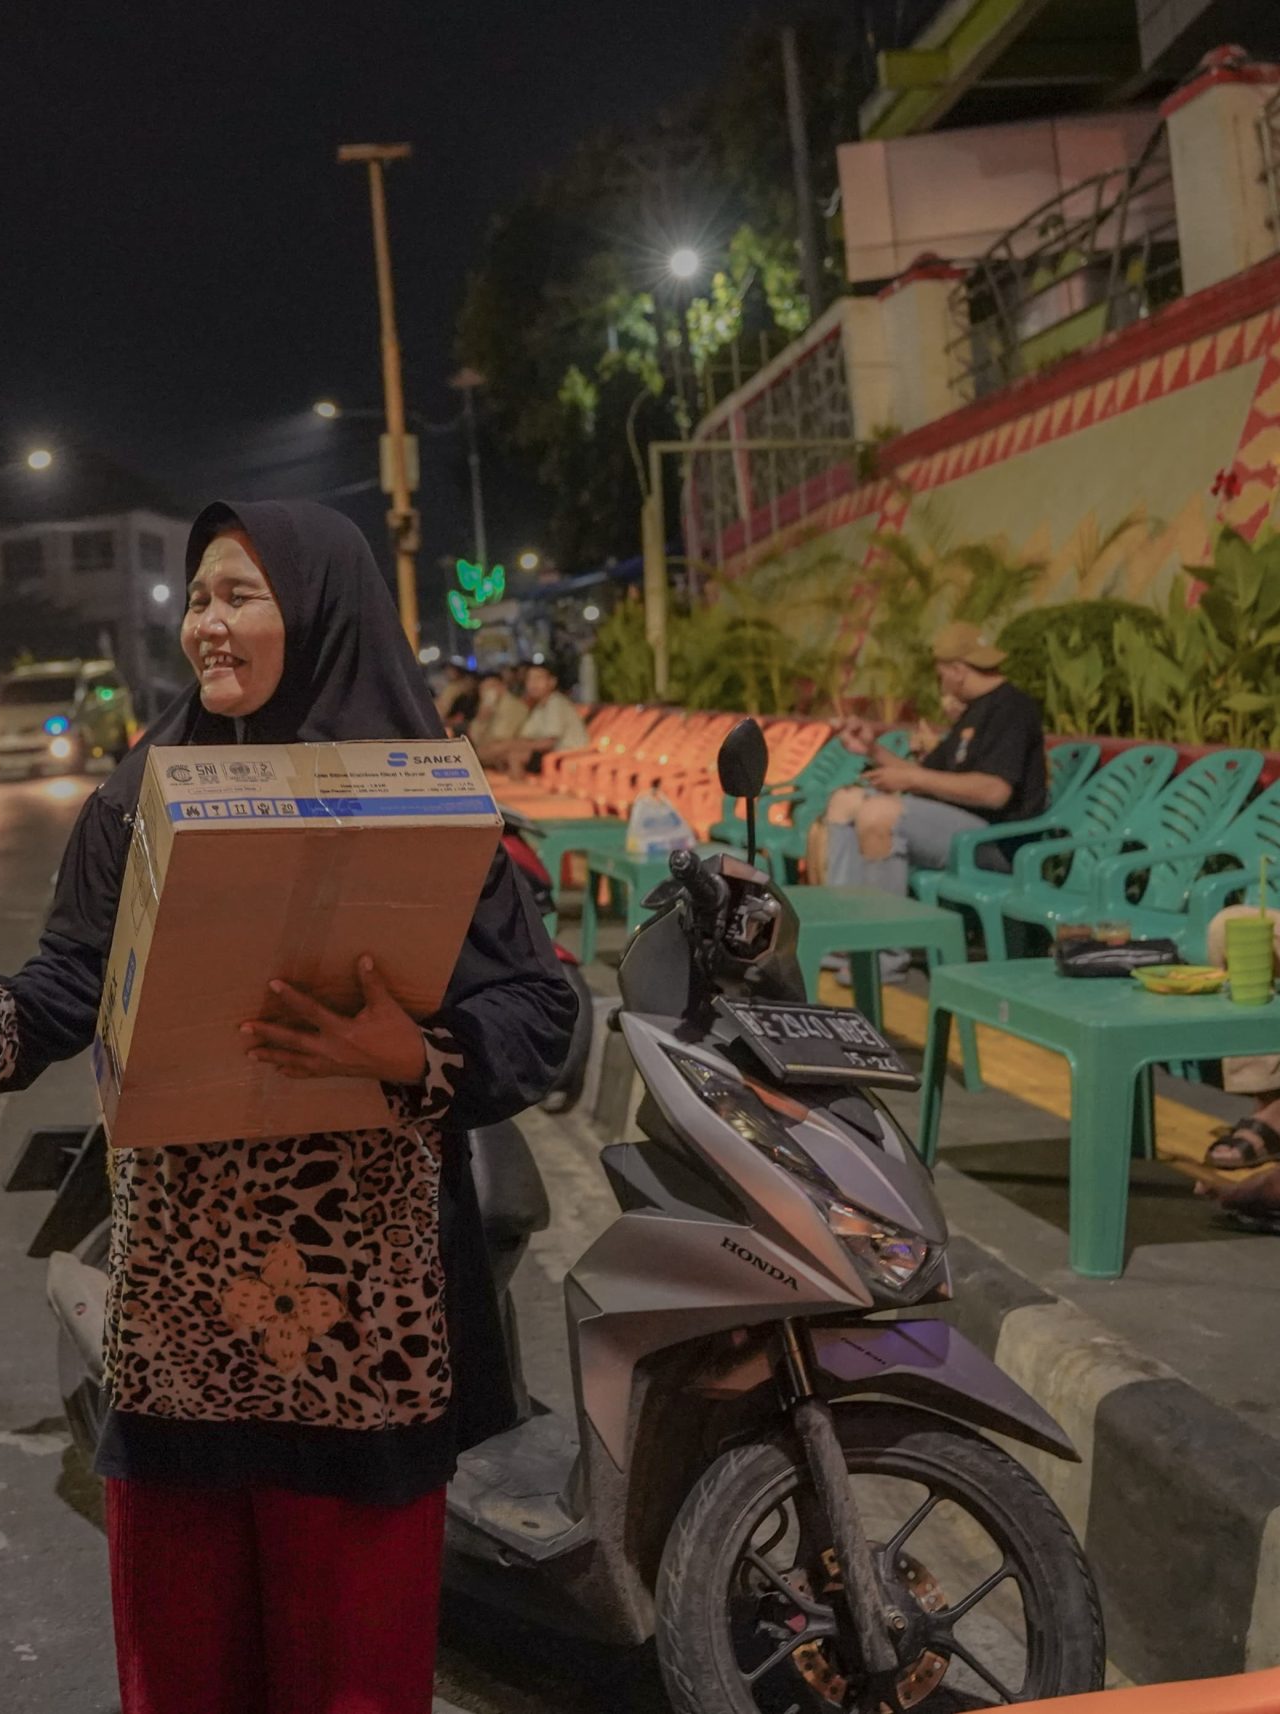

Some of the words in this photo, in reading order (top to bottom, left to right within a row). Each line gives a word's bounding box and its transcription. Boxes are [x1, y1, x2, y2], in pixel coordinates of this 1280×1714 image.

[413, 755, 463, 765] SANEX
[195, 763, 219, 776] SNI
[720, 1236, 799, 1292] HONDA
